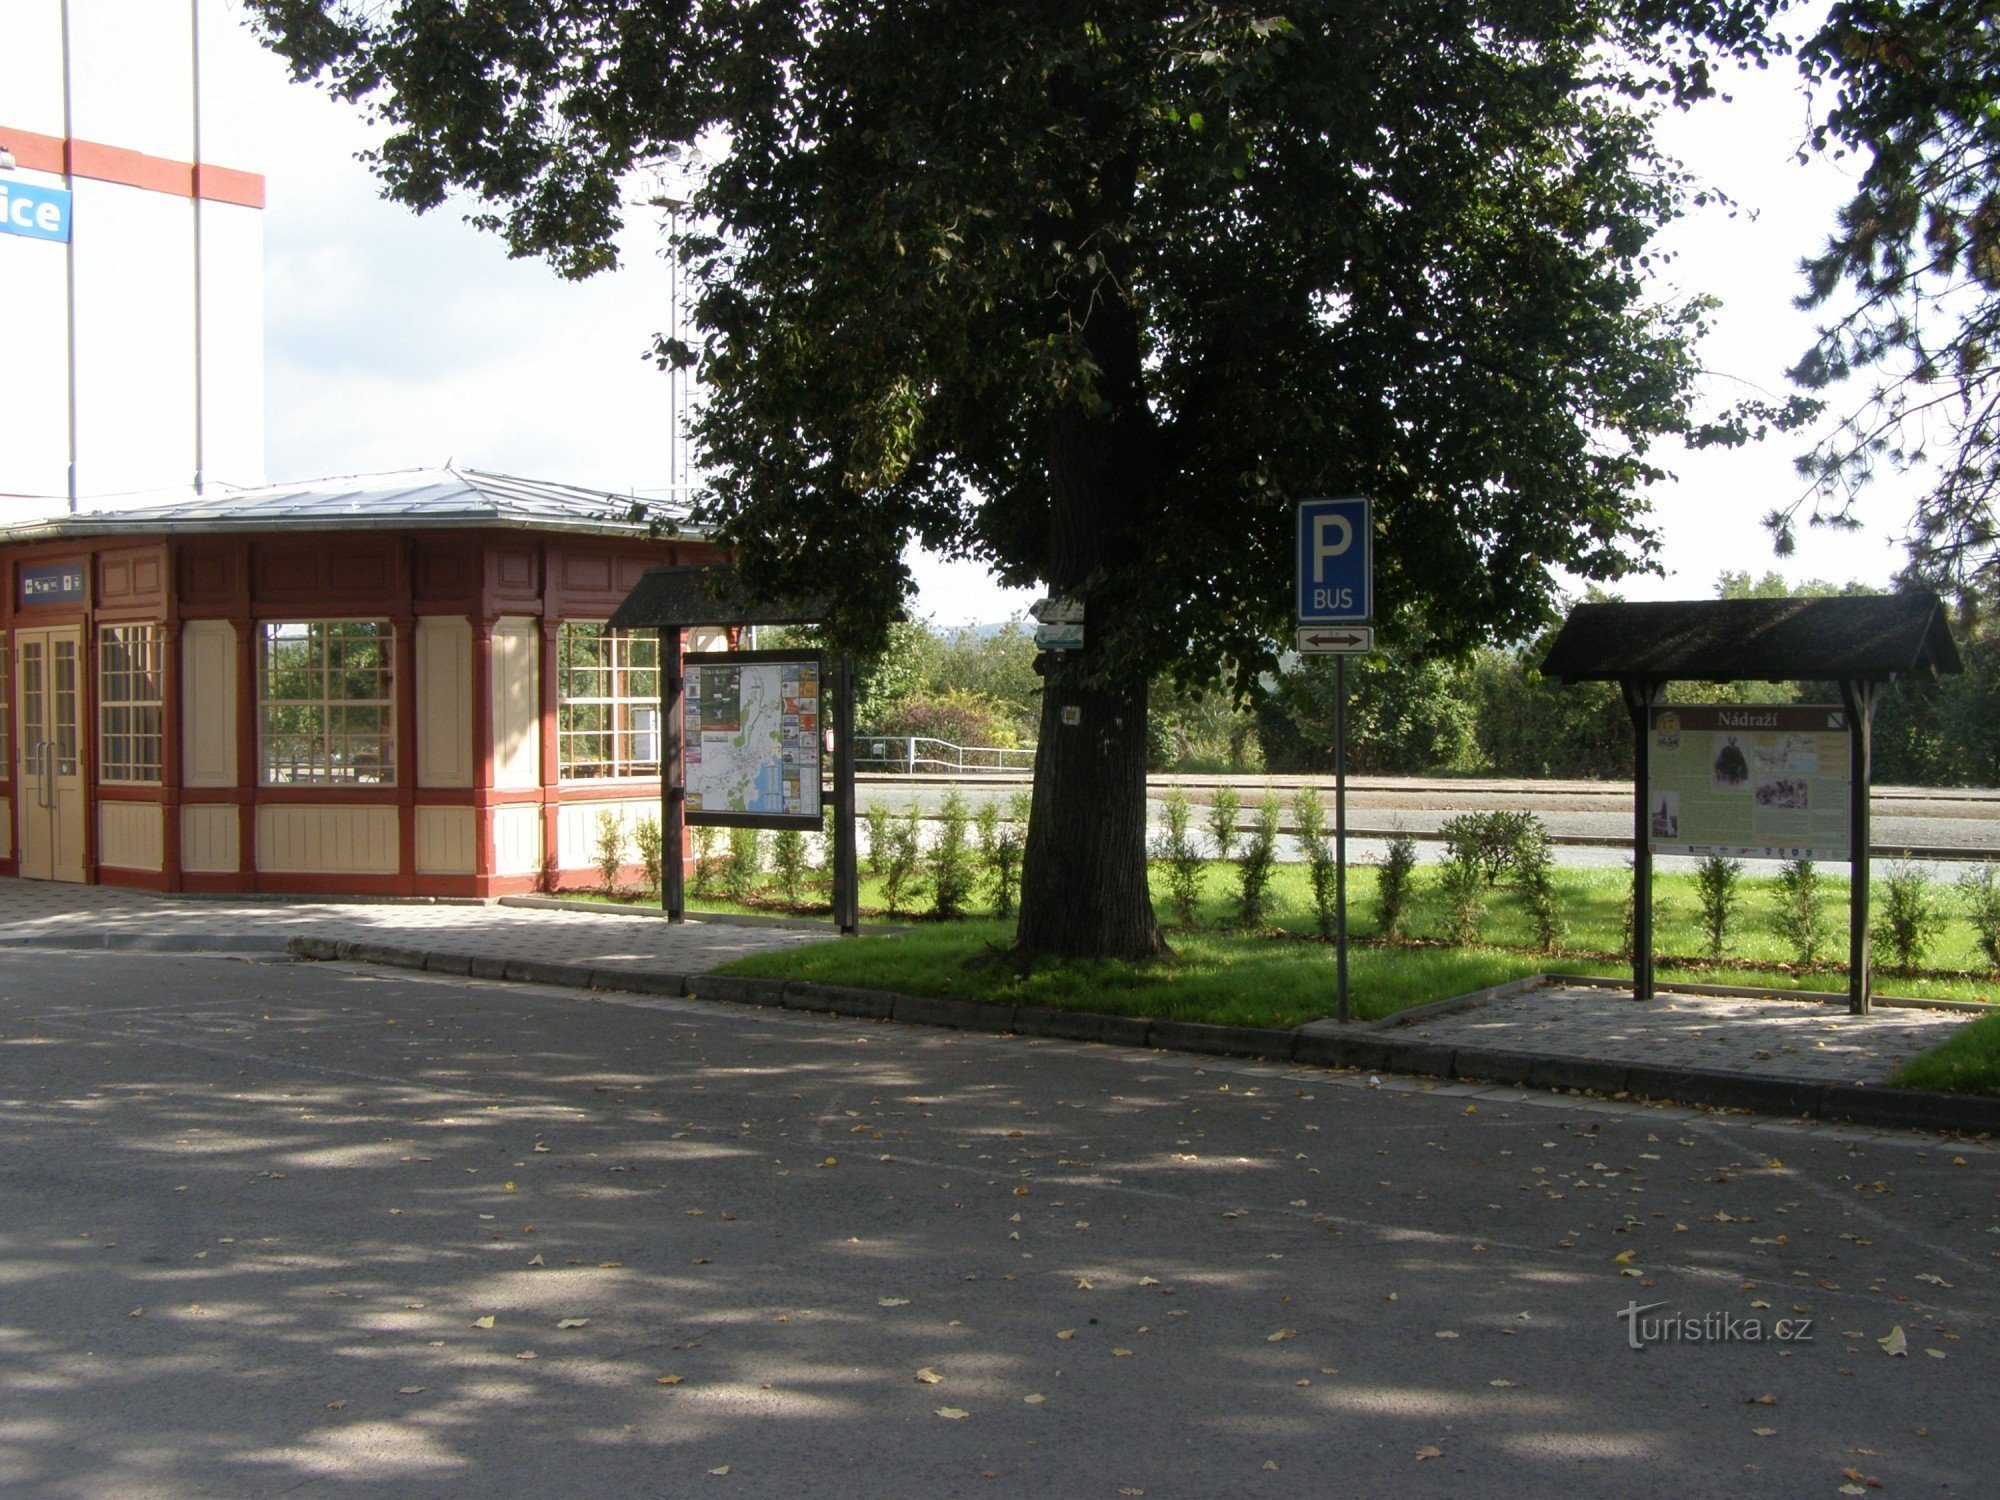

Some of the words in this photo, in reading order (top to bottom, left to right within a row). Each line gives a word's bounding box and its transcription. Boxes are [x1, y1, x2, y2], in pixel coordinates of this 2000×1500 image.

[1313, 514, 1353, 583] P
[1313, 588, 1353, 609] BUS
[1718, 711, 1779, 727] Nádraží
